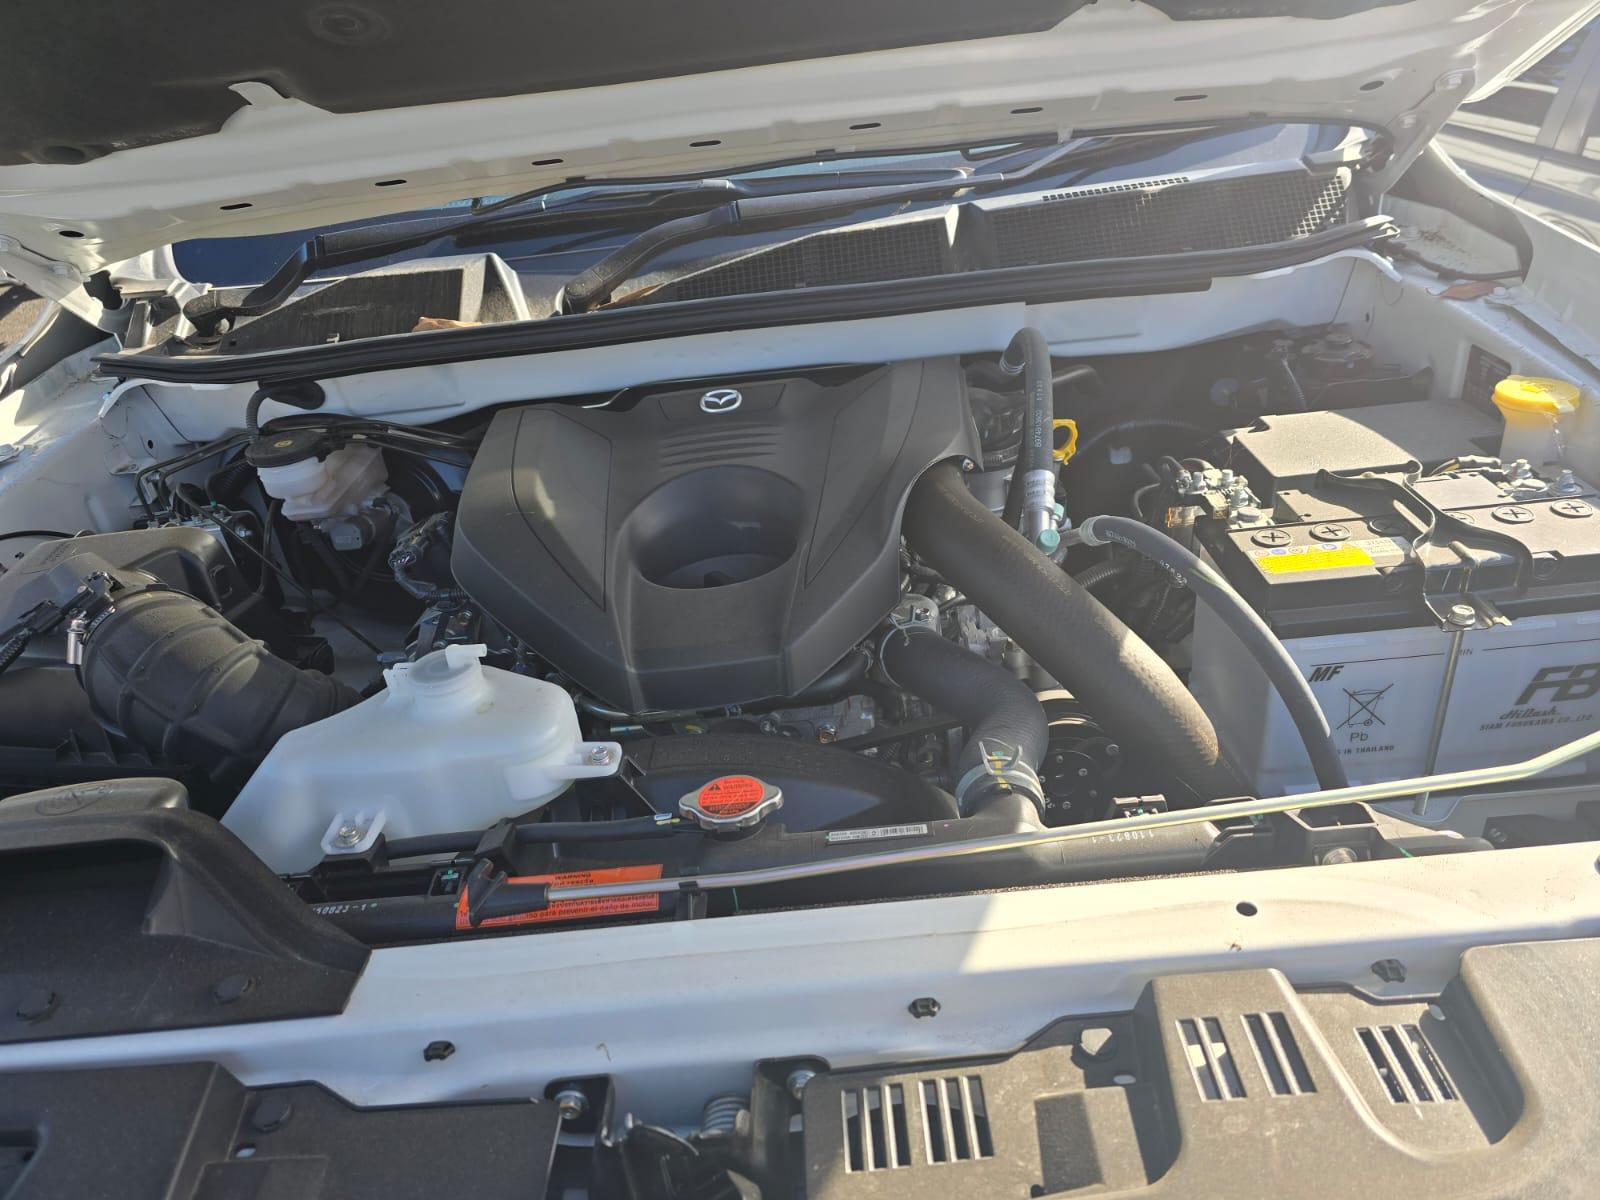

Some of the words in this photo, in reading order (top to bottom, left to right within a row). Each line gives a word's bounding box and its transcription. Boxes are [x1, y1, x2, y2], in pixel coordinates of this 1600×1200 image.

[1309, 665, 1345, 683] MF
[1350, 731, 1369, 743] Pb
[1356, 745, 1395, 754] THAILAND
